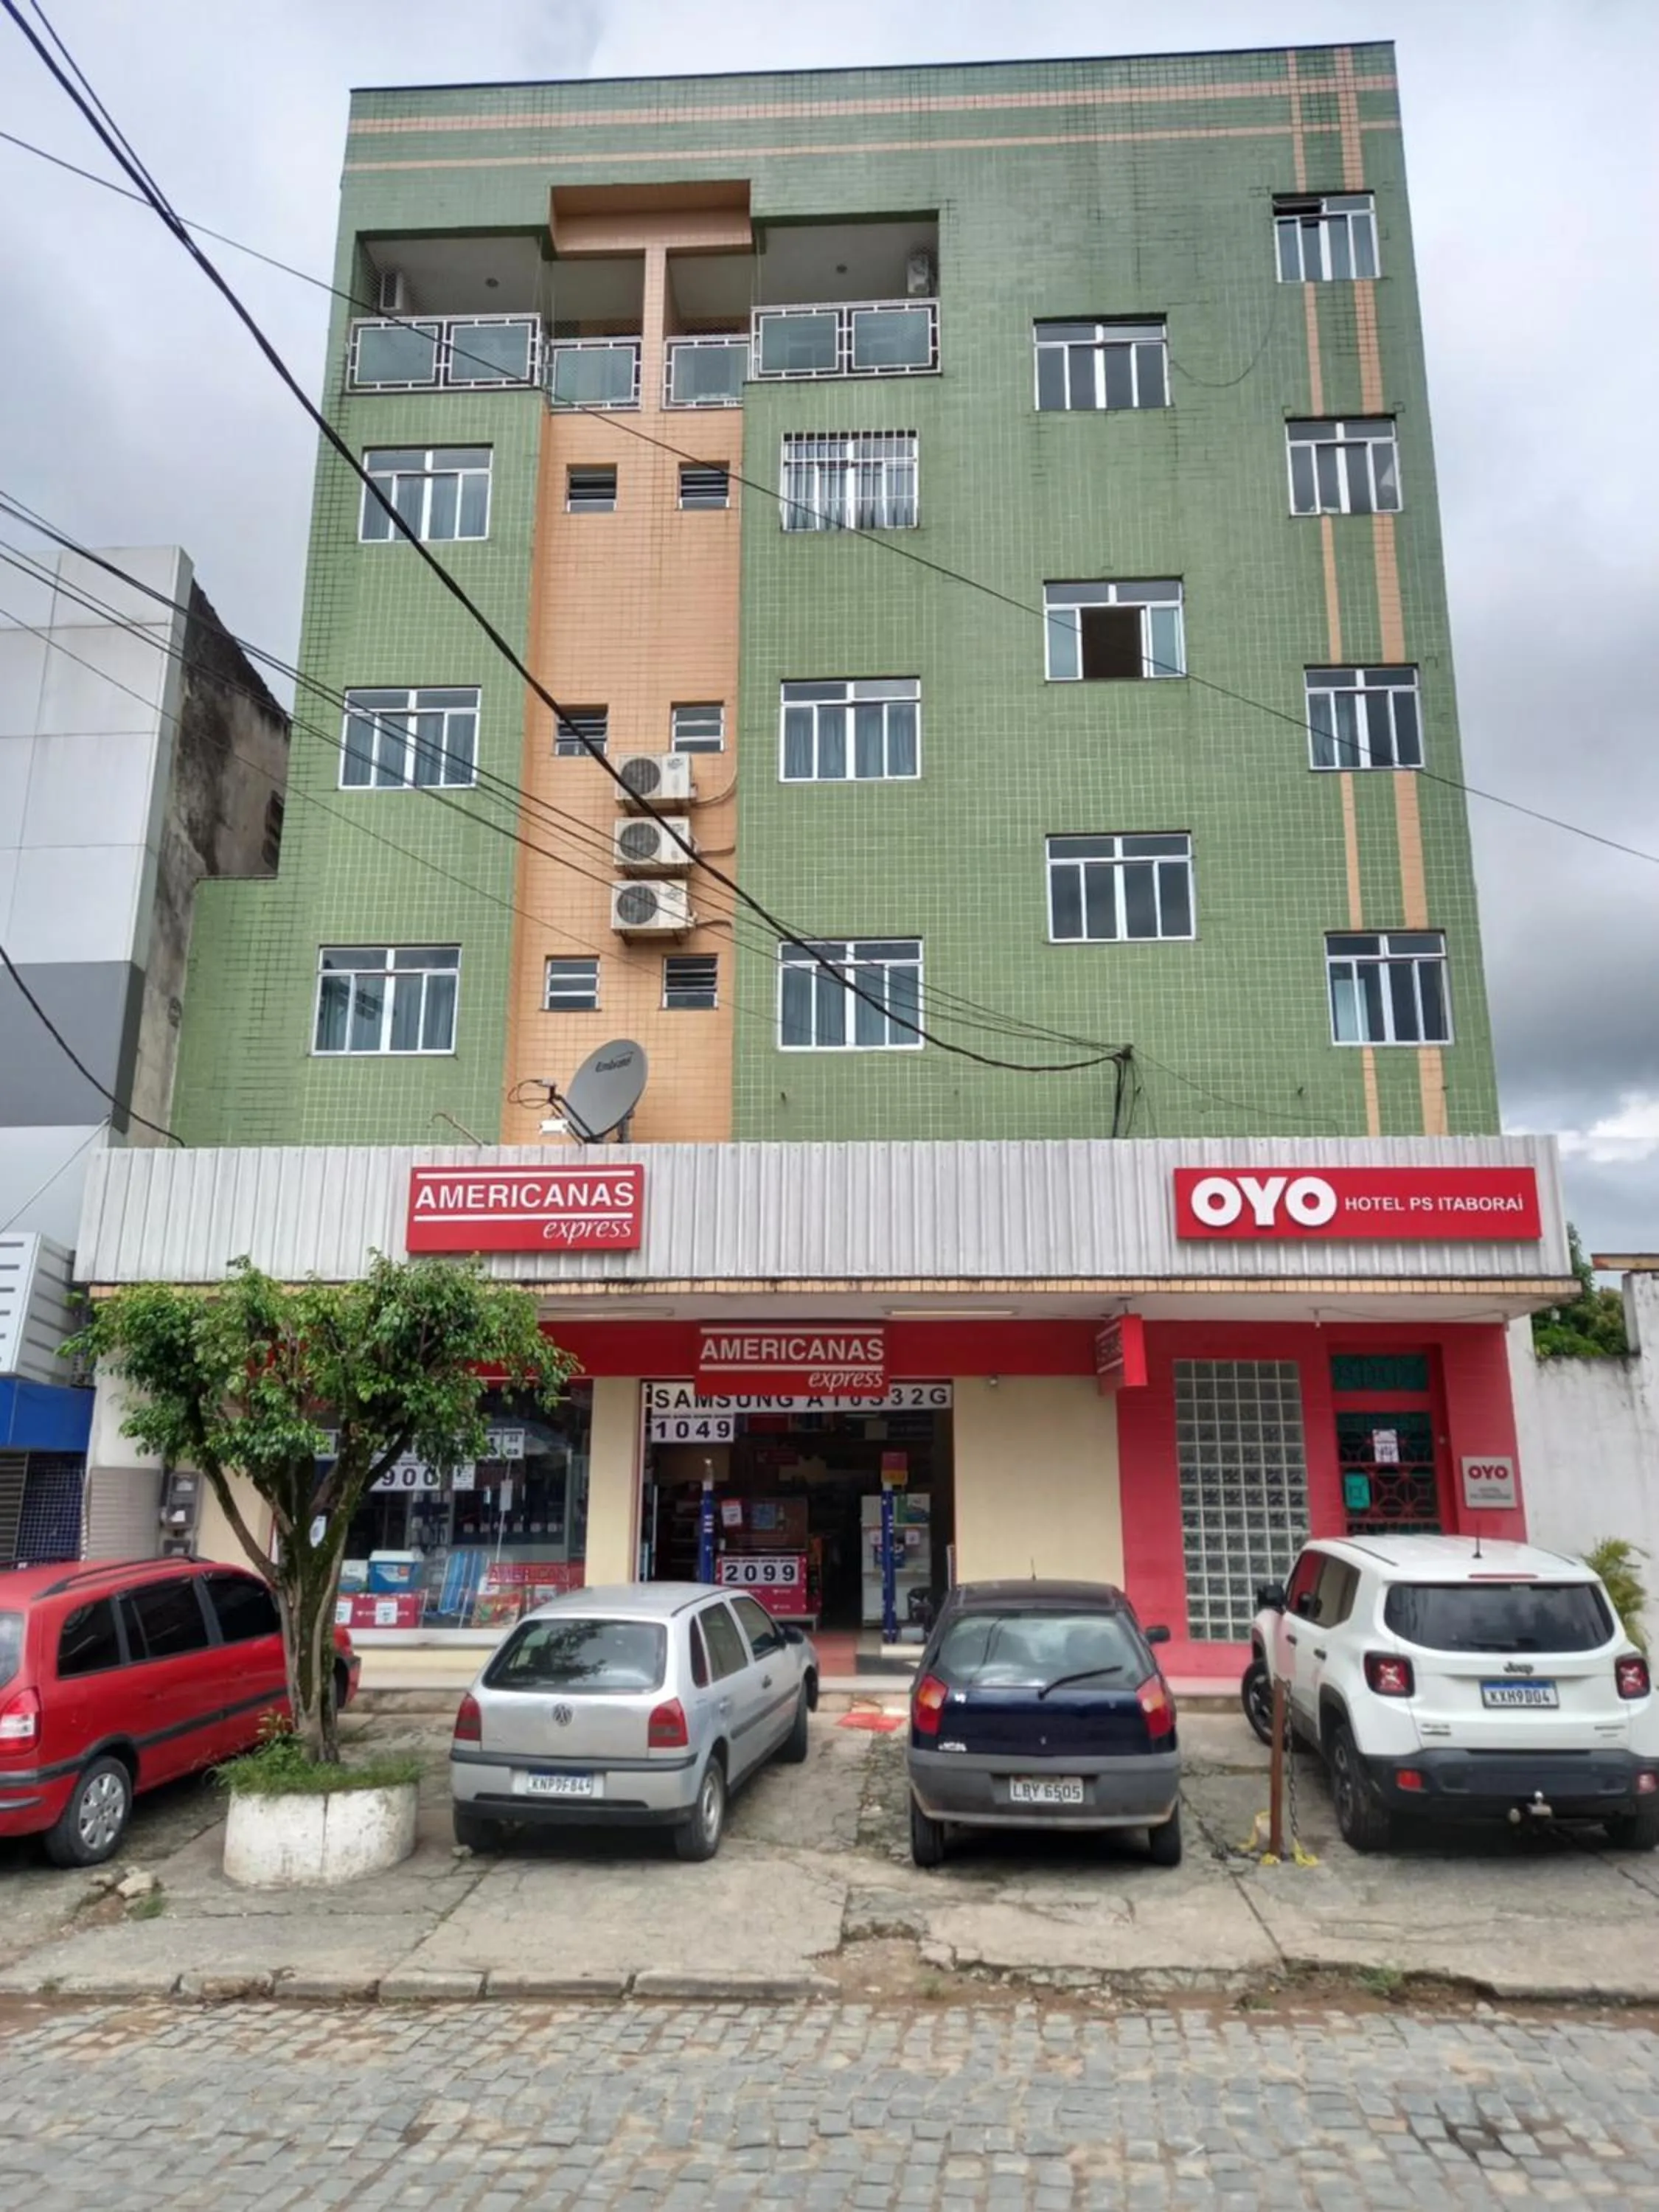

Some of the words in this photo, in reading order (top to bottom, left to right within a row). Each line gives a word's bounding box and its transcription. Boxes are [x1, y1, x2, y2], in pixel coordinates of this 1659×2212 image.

[415, 1182, 634, 1209] AMERICANAS
[1191, 1177, 1338, 1227] OYO
[1344, 1196, 1405, 1211] HOTEL
[1410, 1196, 1433, 1211] PS
[543, 1218, 632, 1245] express
[700, 1338, 884, 1361] AMERICANAS
[808, 1370, 883, 1393] express
[655, 1388, 794, 1409] SAMSUNG
[655, 1420, 731, 1439] 1049
[1468, 1465, 1509, 1480] OYO
[725, 1565, 795, 1582] 2099
